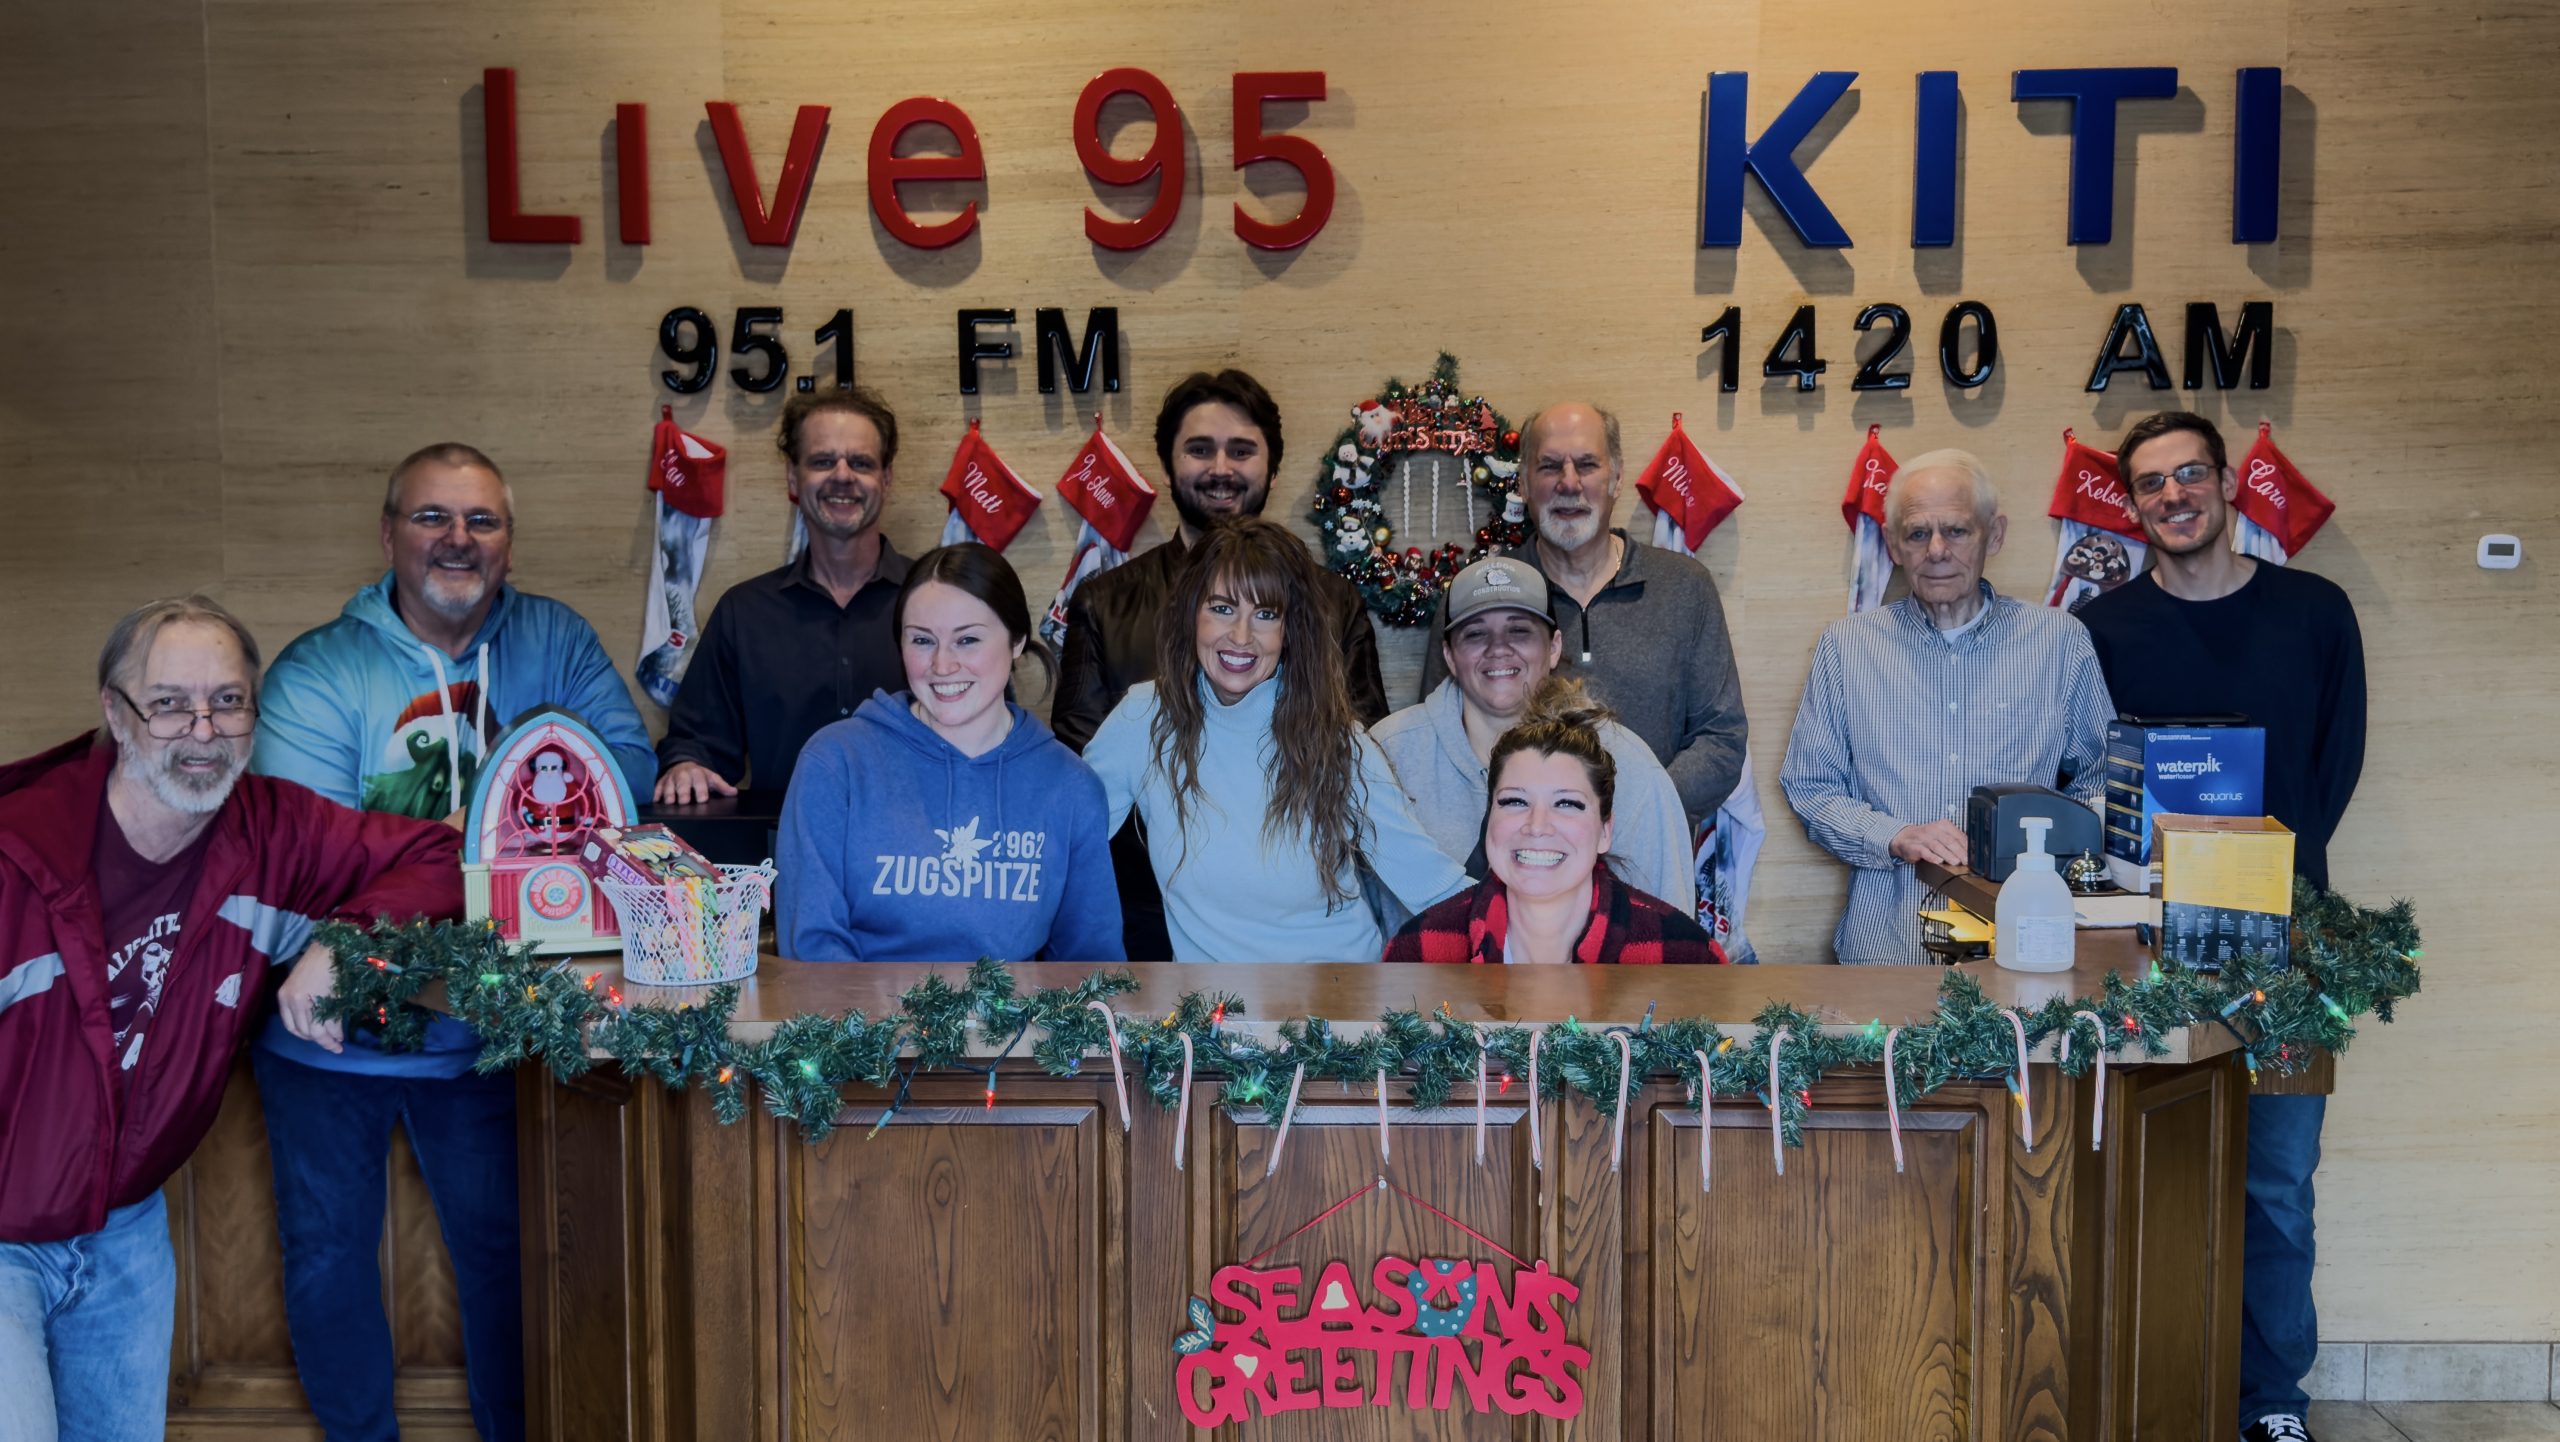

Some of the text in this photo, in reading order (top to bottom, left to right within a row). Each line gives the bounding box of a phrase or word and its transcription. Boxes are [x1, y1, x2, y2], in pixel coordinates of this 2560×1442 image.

[1073, 67, 1335, 251] 95
[1701, 66, 2282, 249] KITI
[658, 307, 1121, 395] 95.1 FM
[1701, 301, 2274, 392] 1420 AM
[963, 461, 1004, 514] Matt
[1473, 585, 1521, 597] CONSTRUCTION
[2156, 752, 2223, 775] waterpik
[2199, 791, 2244, 803] aquarius
[992, 830, 1046, 859] 2962
[872, 855, 1042, 902] ZUGSPITZE
[1176, 1336, 1592, 1428] GREETINGS
